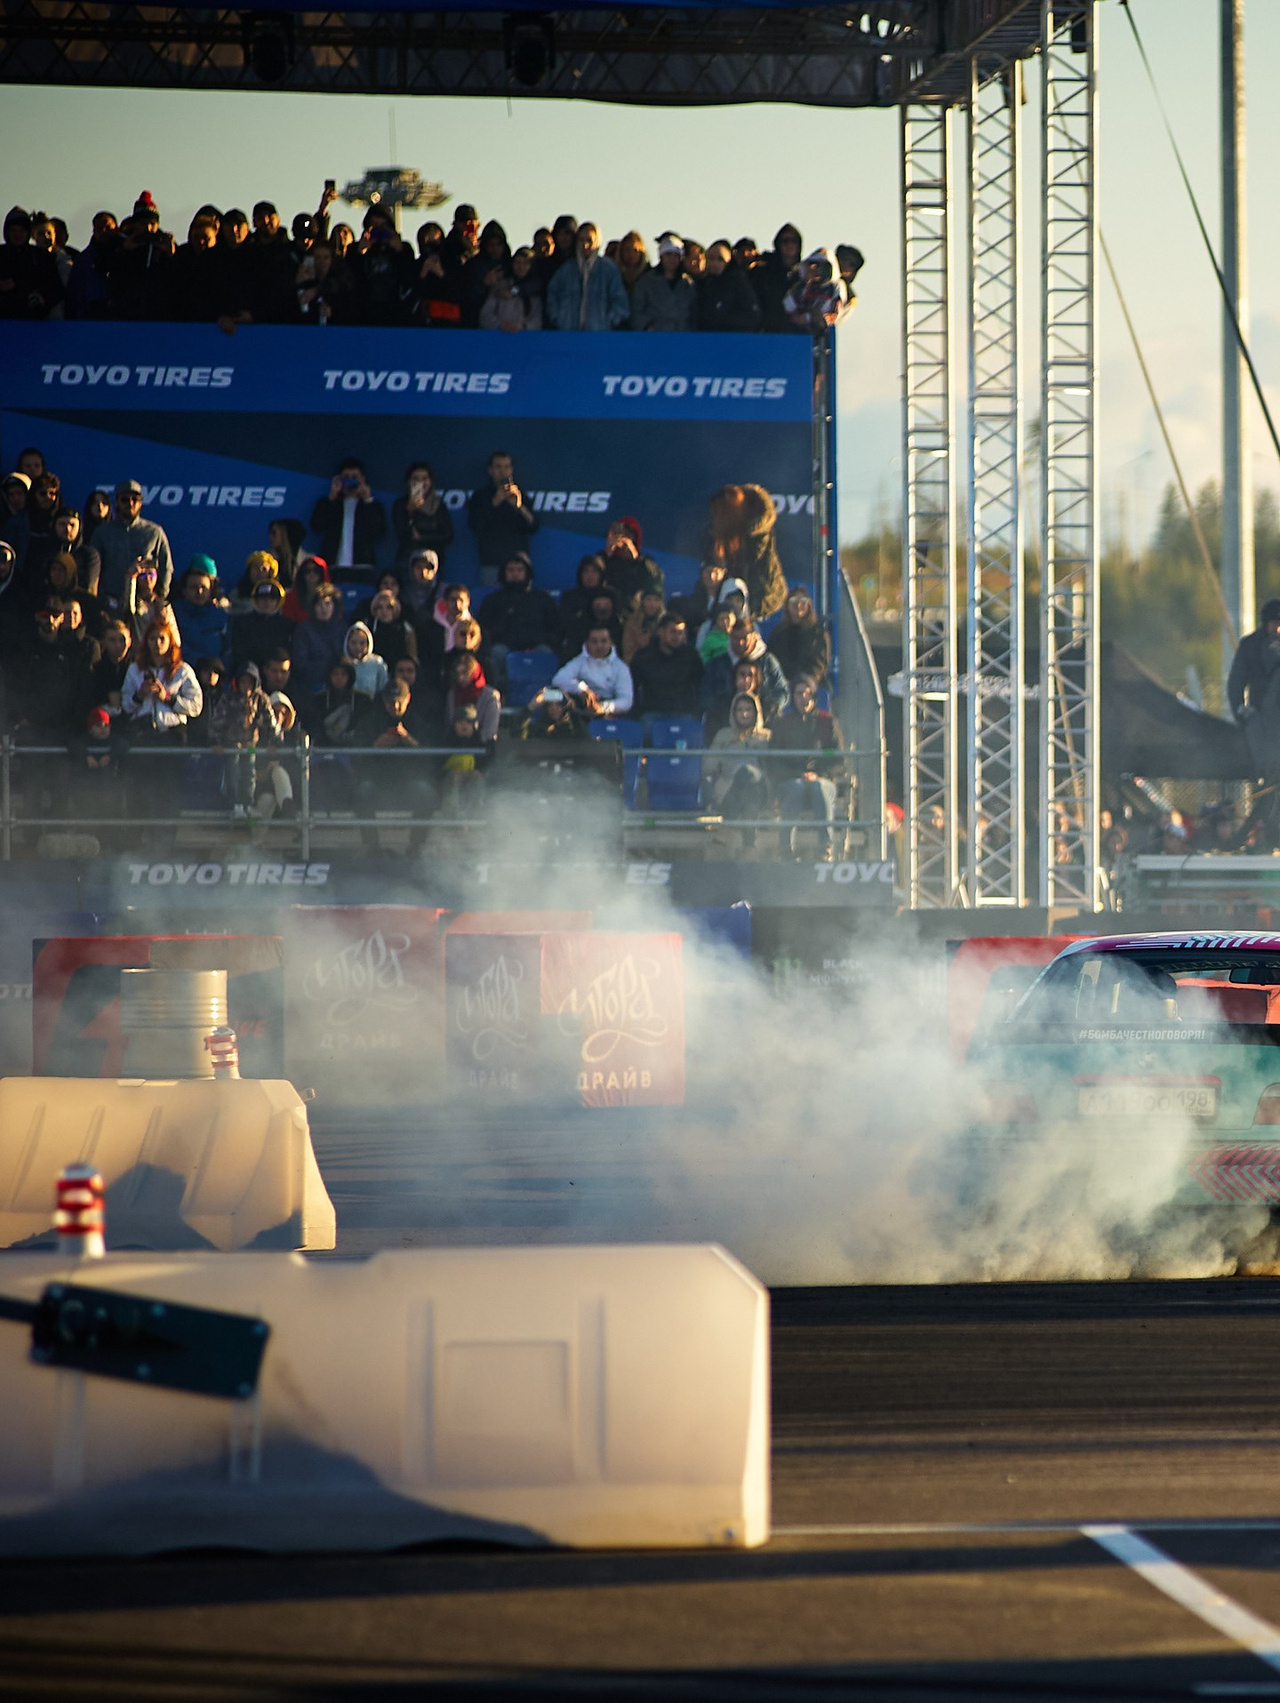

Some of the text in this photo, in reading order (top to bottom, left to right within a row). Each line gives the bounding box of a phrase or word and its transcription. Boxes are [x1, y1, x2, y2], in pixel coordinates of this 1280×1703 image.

[41, 363, 234, 388] TOYO TIRES
[323, 369, 512, 394] TOYO TIRES
[602, 374, 787, 399] TOYO TIRES
[189, 485, 287, 507] TIRES
[528, 490, 611, 513] IRES
[128, 863, 331, 886] TOYO TIRES
[576, 1065, 653, 1093] ДРАЙВ
[1176, 1089, 1208, 1107] 198
